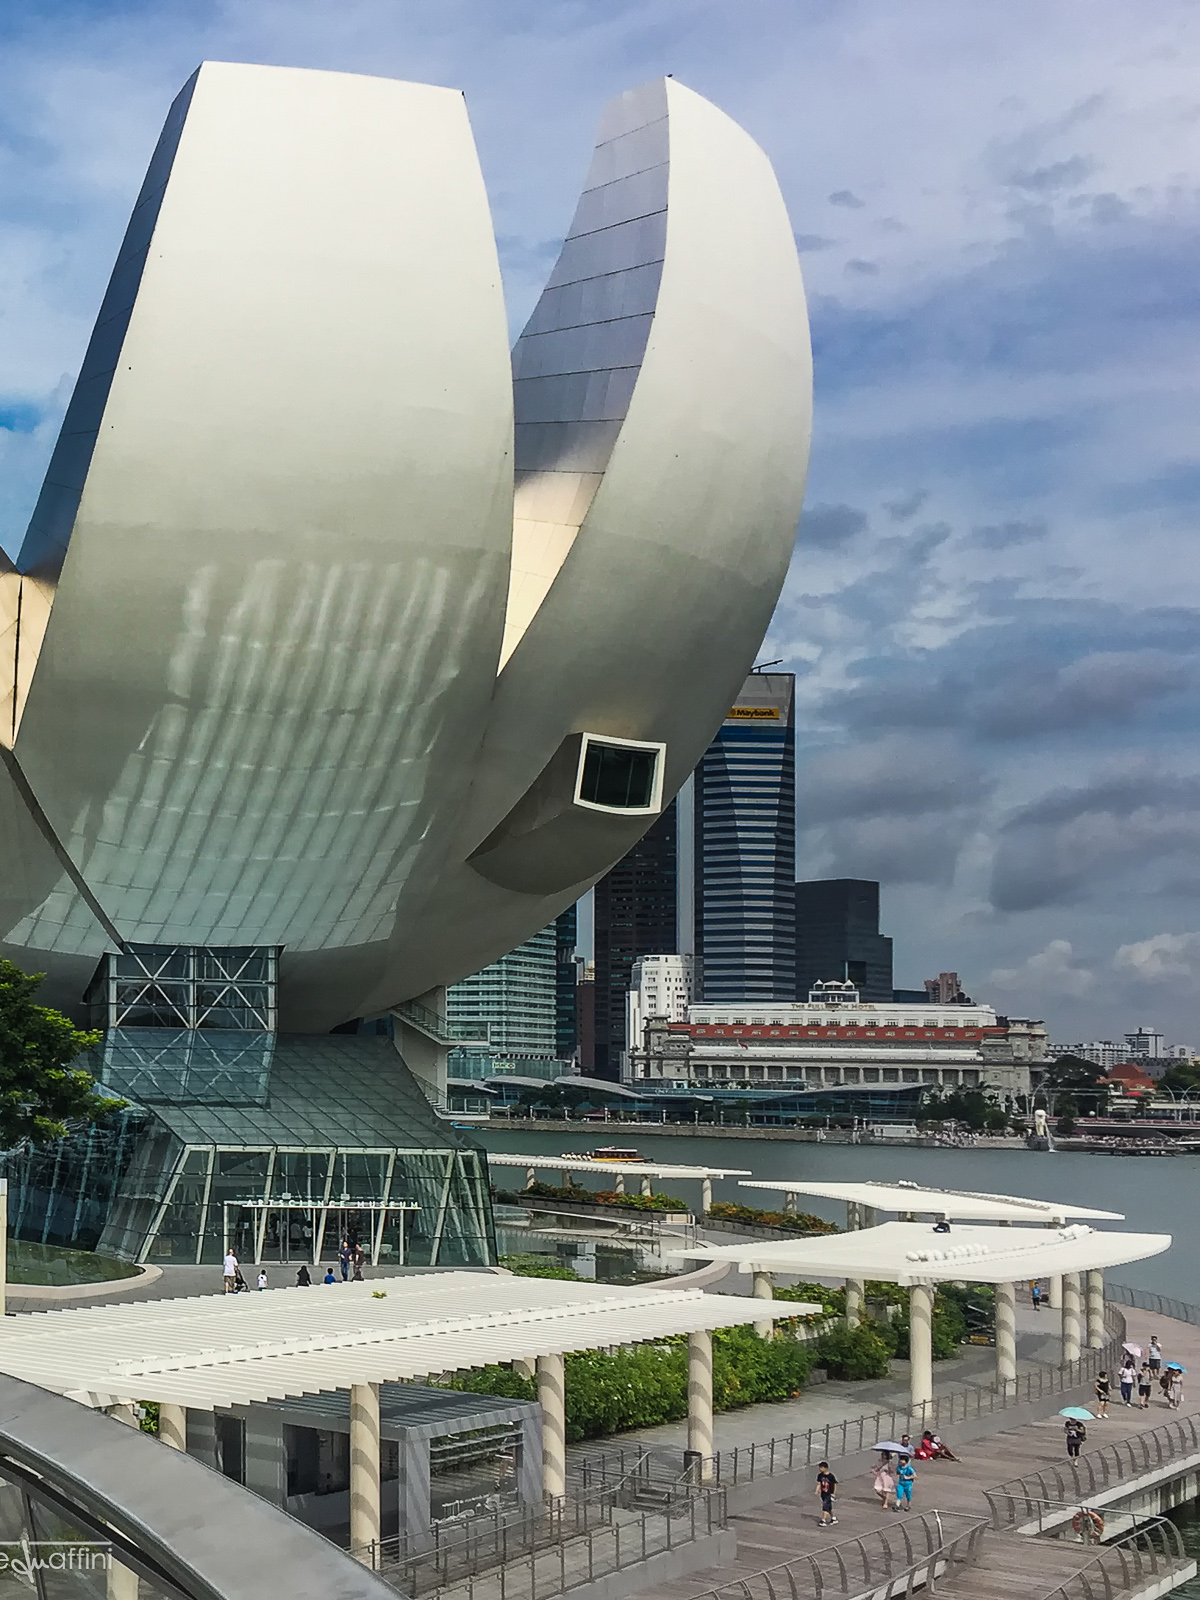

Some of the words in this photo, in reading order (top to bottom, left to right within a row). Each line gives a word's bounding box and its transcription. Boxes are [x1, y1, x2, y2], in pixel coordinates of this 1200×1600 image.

[736, 709, 775, 717] Maybank
[246, 1199, 346, 1207] ARTSCIENCE
[356, 1200, 419, 1209] MUSEUM
